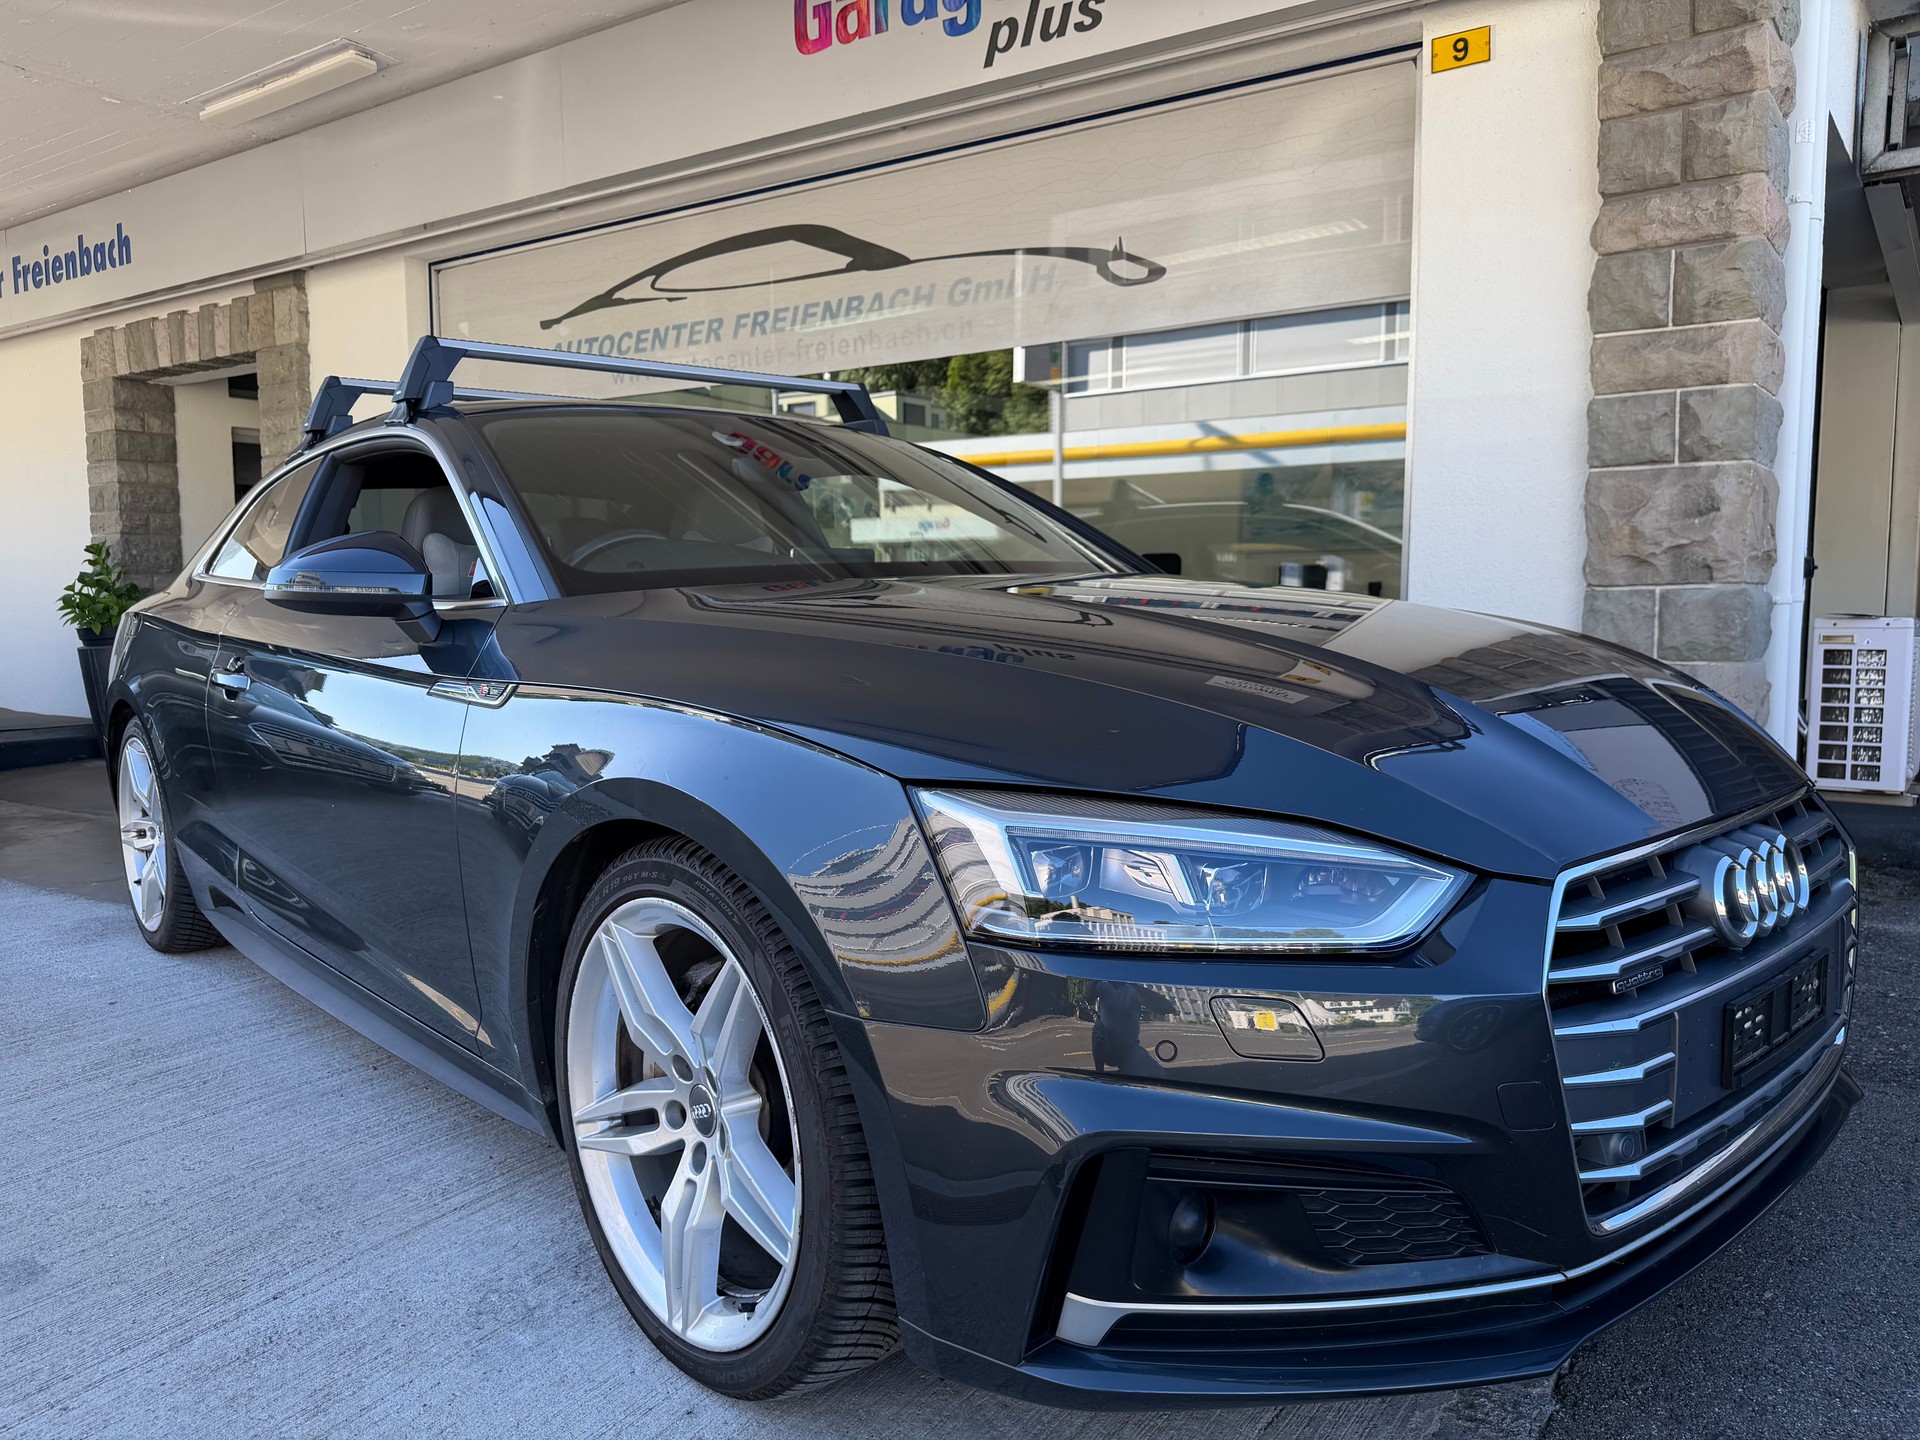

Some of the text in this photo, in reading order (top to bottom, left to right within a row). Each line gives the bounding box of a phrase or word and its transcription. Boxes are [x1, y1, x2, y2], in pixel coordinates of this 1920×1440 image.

[794, 0, 982, 55] Garag
[984, 0, 1104, 69] plus
[1452, 37, 1469, 62] 9
[12, 223, 132, 295] Freienbach
[732, 283, 937, 340] FREIENBACH
[694, 880, 733, 916] ROTATION
[1616, 968, 1661, 991] quattro
